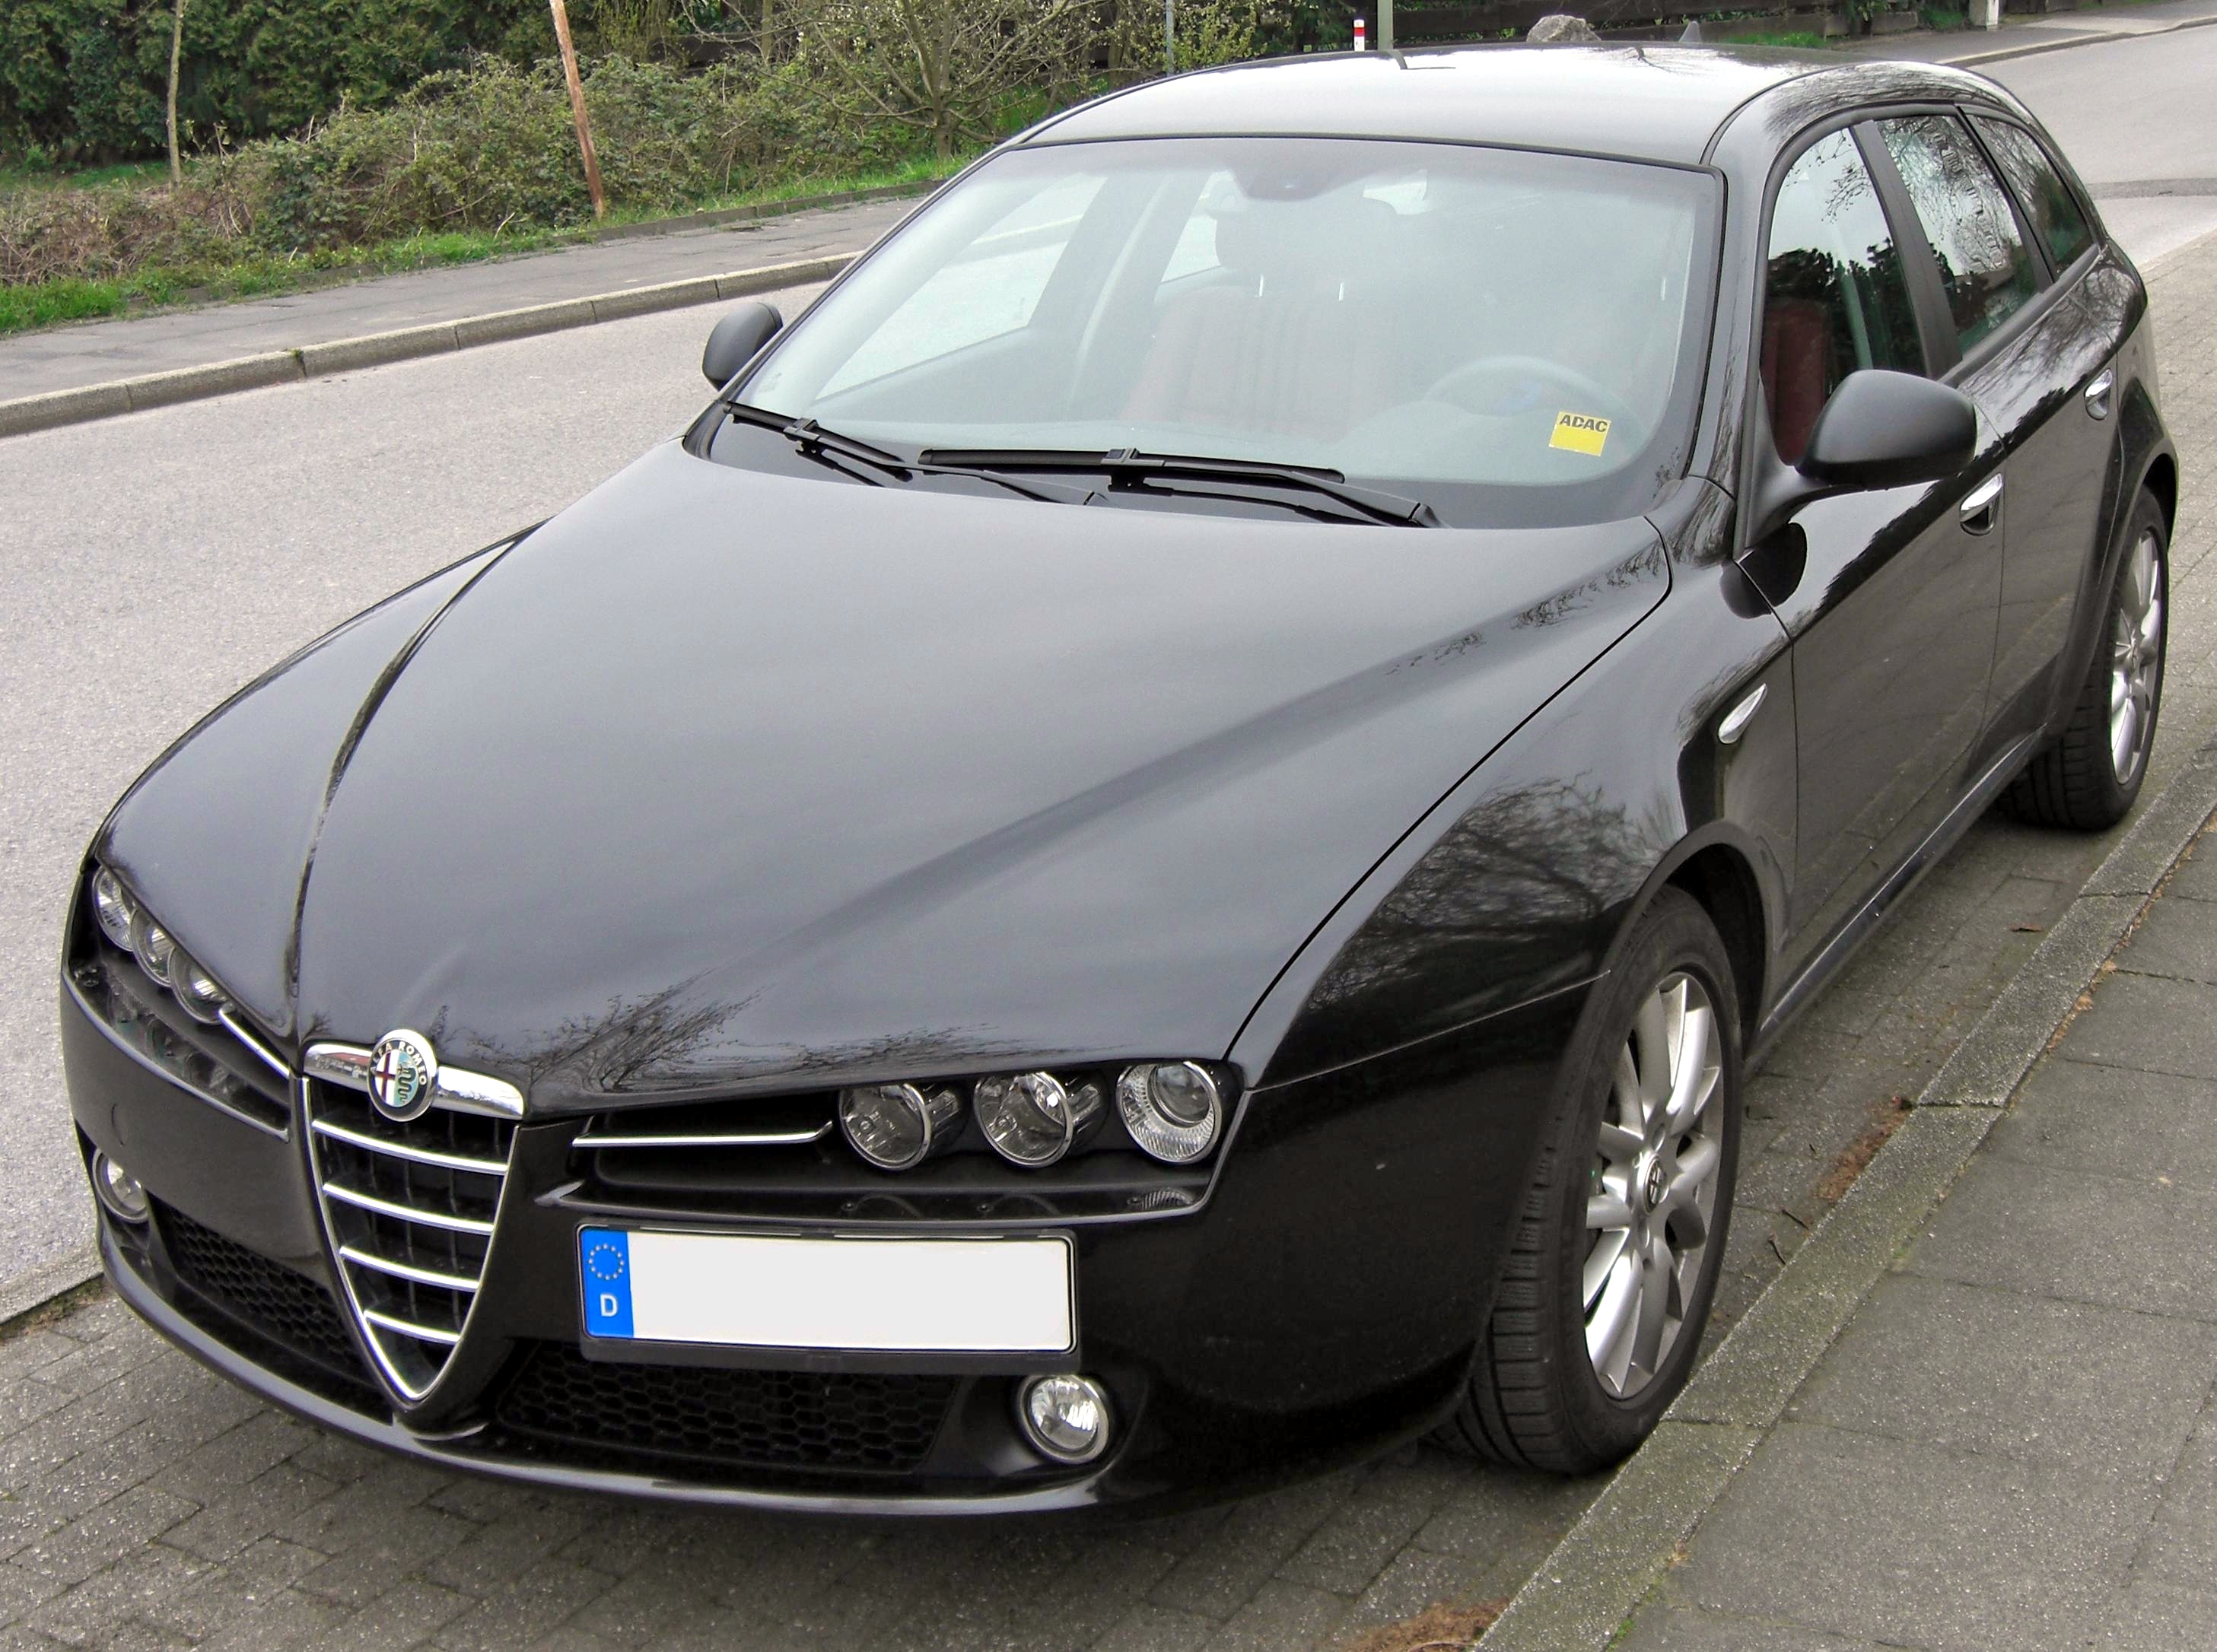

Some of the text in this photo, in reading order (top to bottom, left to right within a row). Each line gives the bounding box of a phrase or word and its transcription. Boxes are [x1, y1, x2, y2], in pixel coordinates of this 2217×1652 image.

[1560, 414, 1608, 432] ADAC
[398, 1040, 427, 1086] ROMEO
[600, 1293, 619, 1317] D
